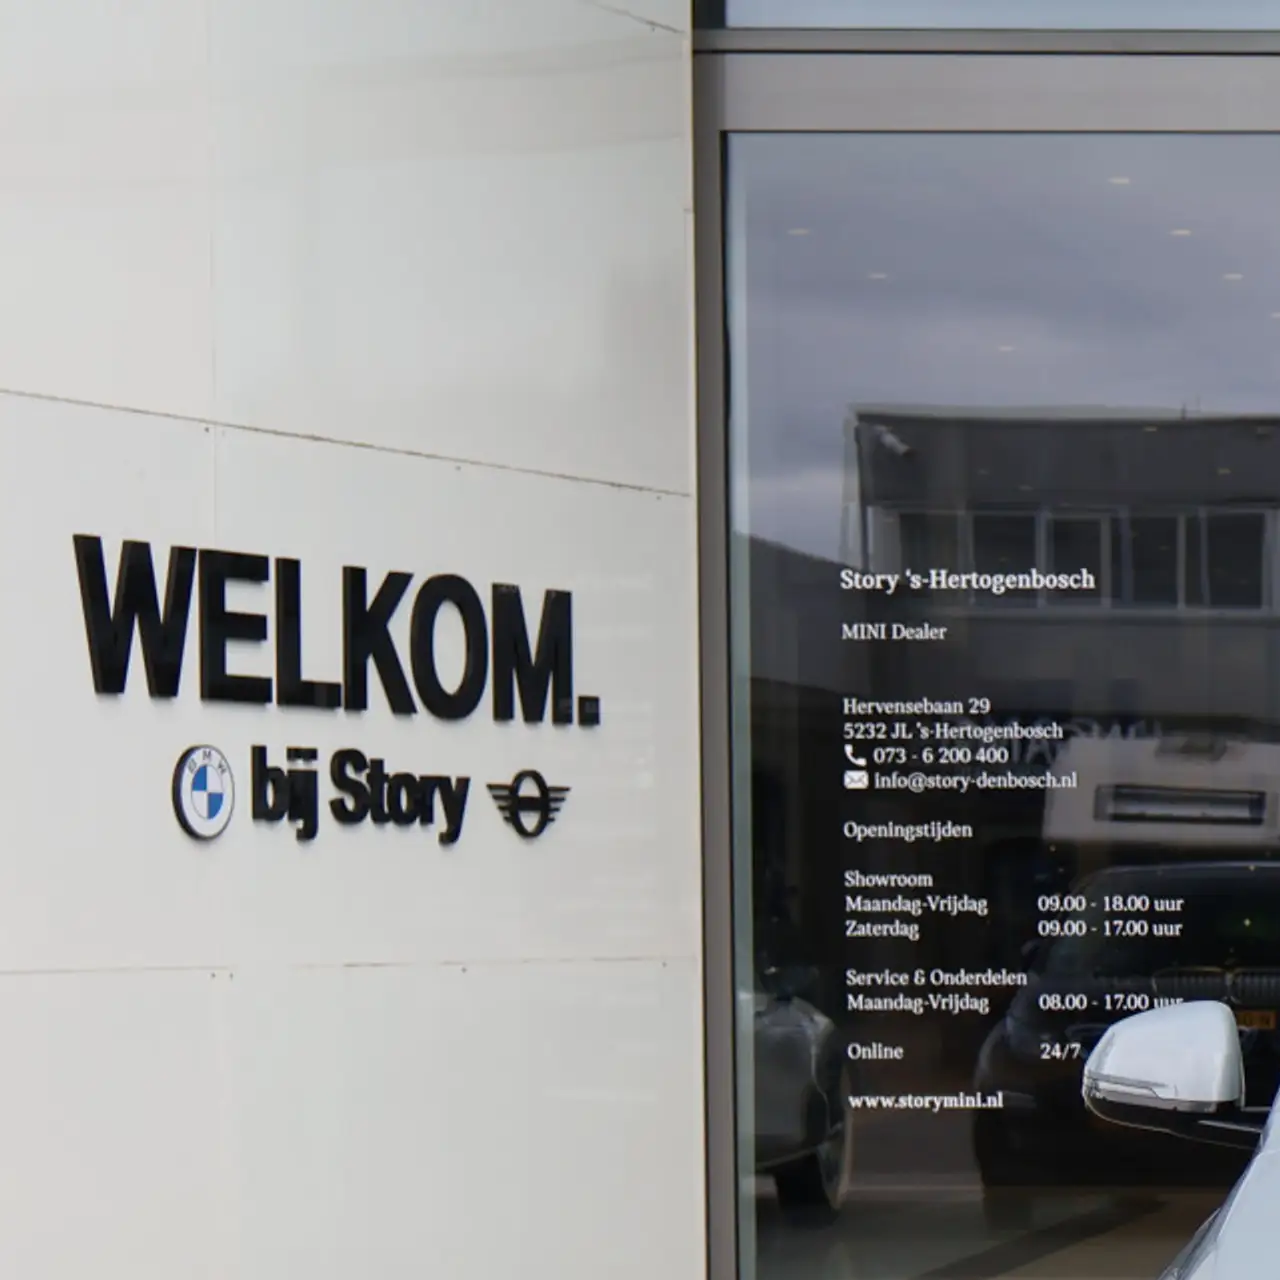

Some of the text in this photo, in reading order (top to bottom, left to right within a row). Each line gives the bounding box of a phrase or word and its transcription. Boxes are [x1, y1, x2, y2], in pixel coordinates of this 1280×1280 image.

[841, 570, 898, 594] Story
[73, 534, 600, 726] WELKOM.
[842, 624, 946, 640] MINI Dealer
[843, 698, 990, 714] Hervensebaan 29
[843, 723, 886, 739] 5232
[891, 723, 912, 740] JL
[873, 748, 906, 764] 073
[923, 748, 933, 764] 6
[936, 748, 971, 764] 200
[975, 748, 1008, 764] 400
[874, 772, 1077, 792] info@story-denbosch.nl
[330, 748, 470, 844] Story
[844, 821, 972, 842] Openingstijden
[845, 871, 933, 888] Showroom
[846, 895, 988, 917] Maandag-Vrijdag
[1038, 896, 1086, 911] 09.00
[1103, 896, 1149, 911] 18.00
[1153, 899, 1184, 911] uur
[846, 920, 919, 941] Zaterdag
[1038, 921, 1086, 936] 09.00
[1103, 921, 1149, 936] 17.00
[1153, 924, 1182, 936] uur
[846, 969, 1027, 986] Service & Onderdelen
[847, 994, 989, 1015] Maandag-Vrijdag
[1039, 995, 1087, 1010] 08.00
[1104, 995, 1149, 1010] 17.00
[847, 1044, 1081, 1060] Online 24/7
[848, 1092, 1004, 1113] www.storymini.nl
